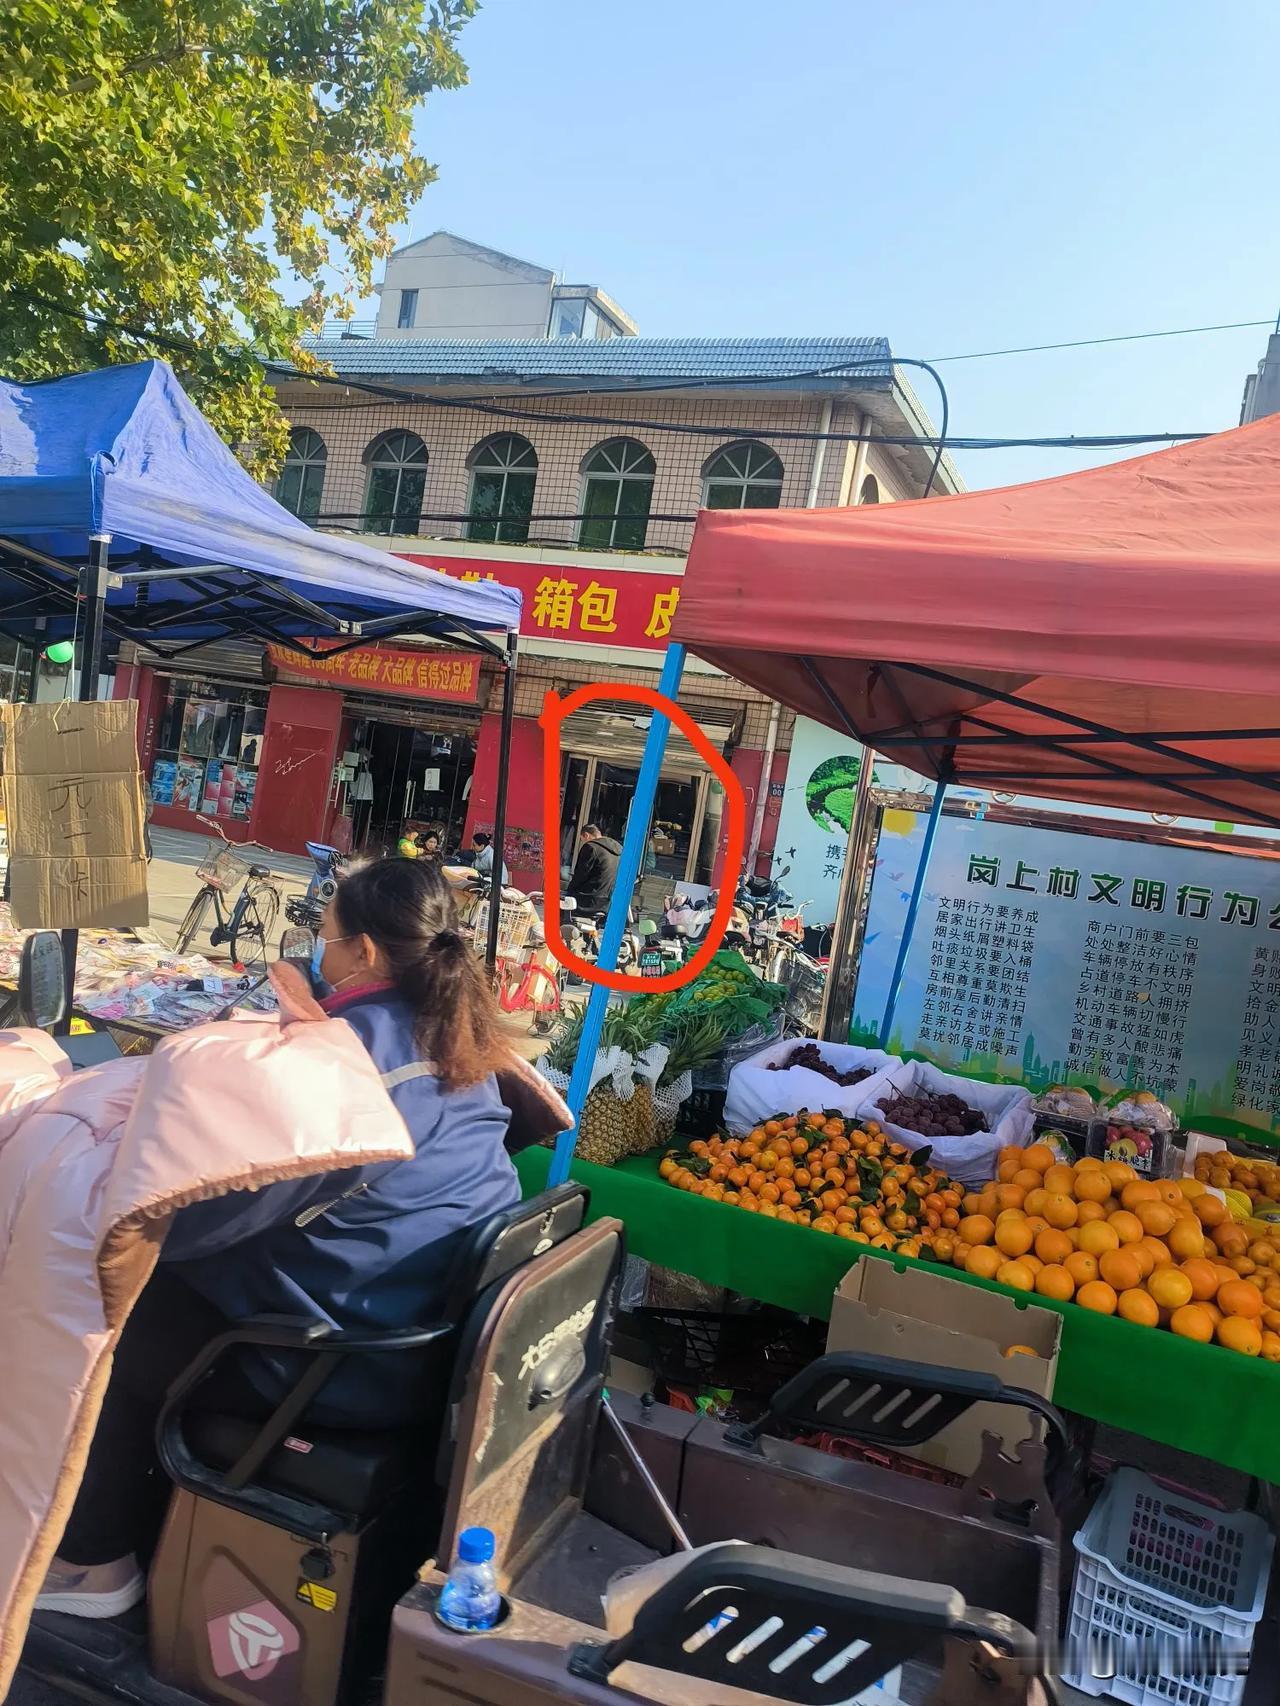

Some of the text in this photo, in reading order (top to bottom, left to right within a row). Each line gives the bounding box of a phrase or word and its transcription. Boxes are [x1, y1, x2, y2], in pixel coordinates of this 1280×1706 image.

[532, 576, 618, 633] 箱包
[348, 652, 382, 681] 老品牌
[381, 655, 416, 686] 大品牌
[416, 658, 473, 693] 信得过品牌
[936, 910, 1036, 938] 居家出行讲卫生
[938, 896, 1039, 923] 文明行为要养成
[934, 925, 1034, 953] 烟头纸屑塑料袋
[1087, 920, 1199, 949] 商户门前要三包
[932, 940, 1032, 968] 吐痰垃圾要入桶
[1084, 935, 1197, 966] 处处整洁好心情
[930, 954, 1030, 983] 邻里关系要团结
[1082, 951, 1194, 981] 车辆停放有秩序
[928, 969, 1027, 997] 互相尊重莫欺生
[1080, 967, 1192, 997] 占道停车不文明
[1249, 979, 1280, 996] 文明
[925, 983, 1026, 1014] 房前屋后勤清扫
[1075, 996, 1187, 1029] 机动车辆切慢行
[1078, 982, 1190, 1013] 乡村道路人拥挤
[1246, 995, 1279, 1013] 拾金
[921, 1013, 1020, 1042] 走亲访友或施工
[923, 998, 1023, 1028] 左邻右舍讲亲情
[1243, 1012, 1275, 1029] 助人
[918, 1026, 1019, 1056] 莫扰邻居成噪声
[1073, 1012, 1185, 1045] 交通事故猛如虎
[1241, 1028, 1280, 1047] 见义
[1068, 1042, 1180, 1076] 勤劳致富善为本
[1071, 1027, 1183, 1061] 曾有多人酿悲痛
[1065, 1057, 1178, 1093] 诚信做人不坑蒙
[1231, 1092, 1280, 1114] 绿化家
